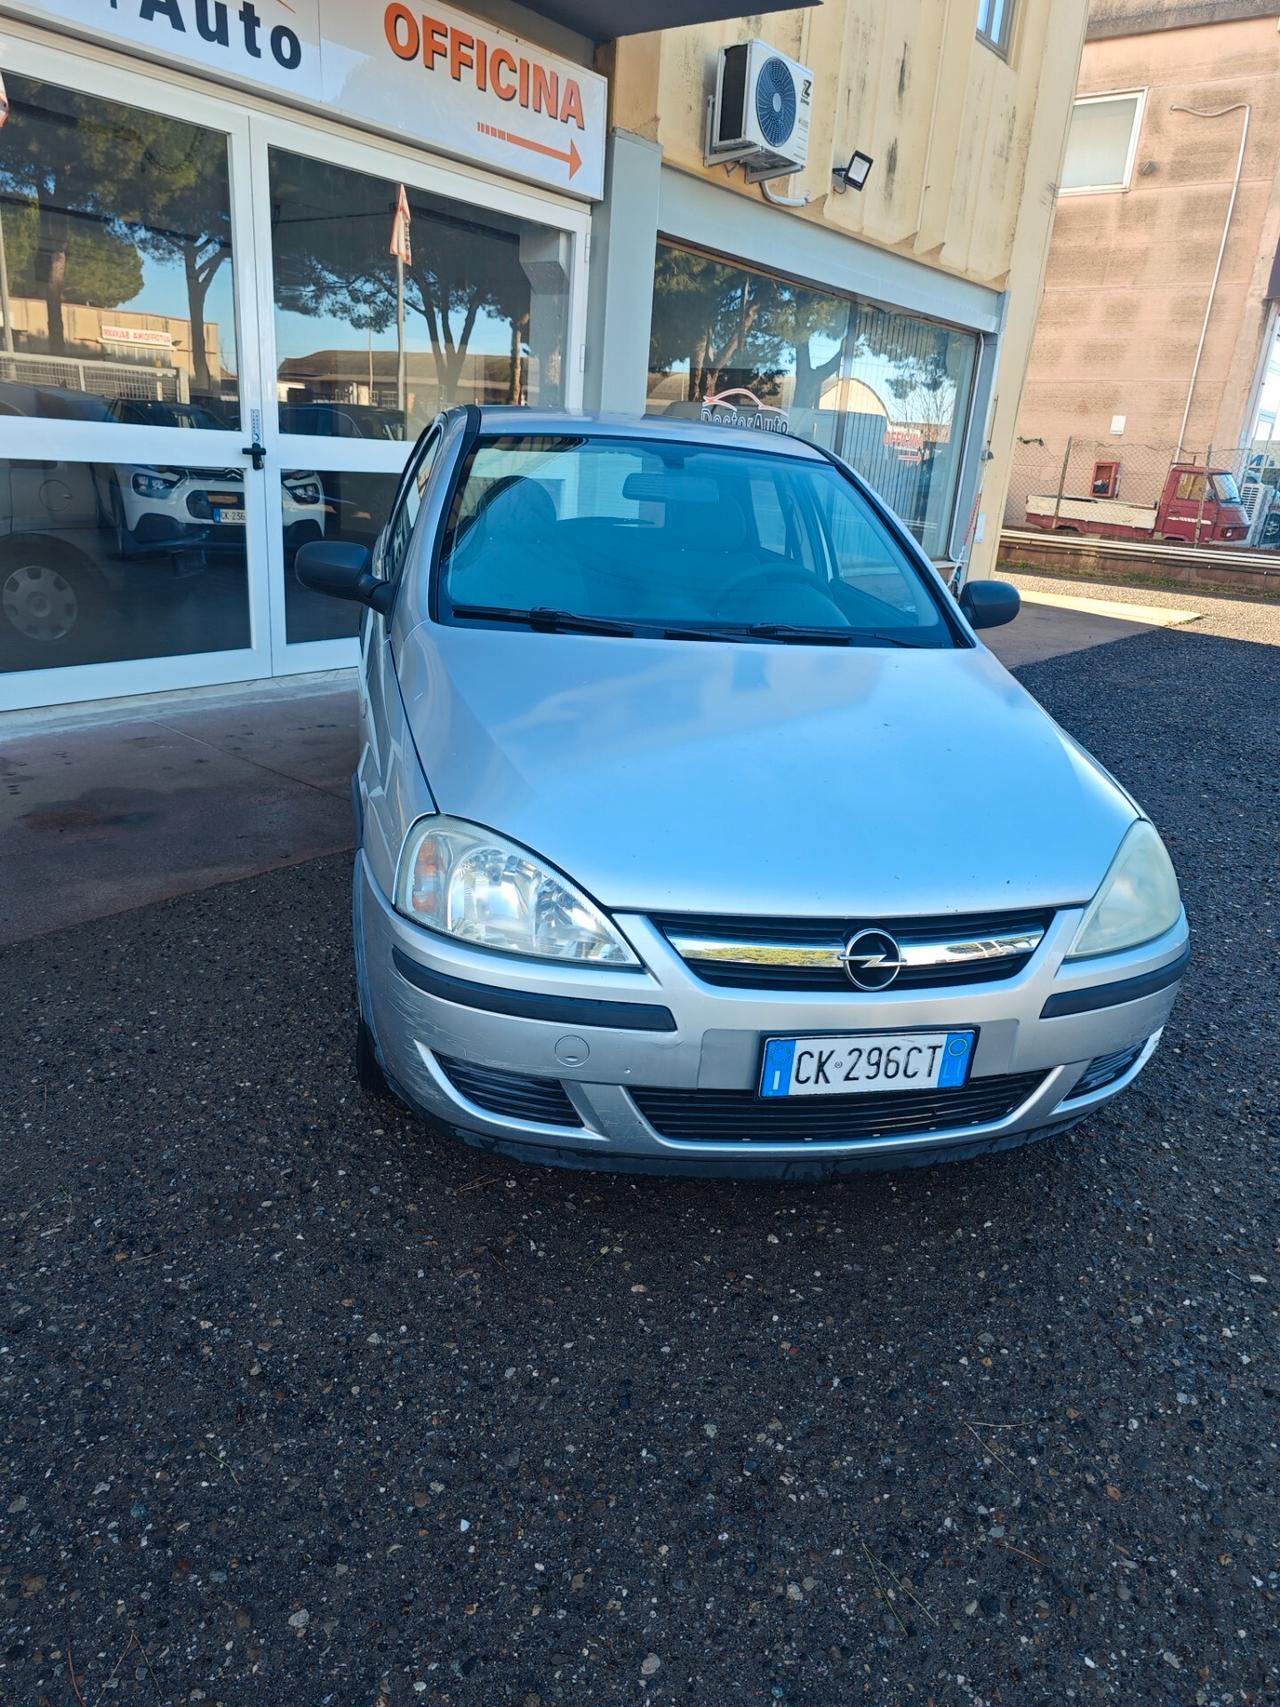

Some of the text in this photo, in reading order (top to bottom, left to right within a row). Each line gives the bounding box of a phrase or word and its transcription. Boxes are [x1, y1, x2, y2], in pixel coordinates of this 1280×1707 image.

[109, 0, 302, 70] Auto
[384, 1, 586, 131] OFFICINA
[794, 1050, 836, 1085] CK
[843, 1045, 943, 1082] 296CT
